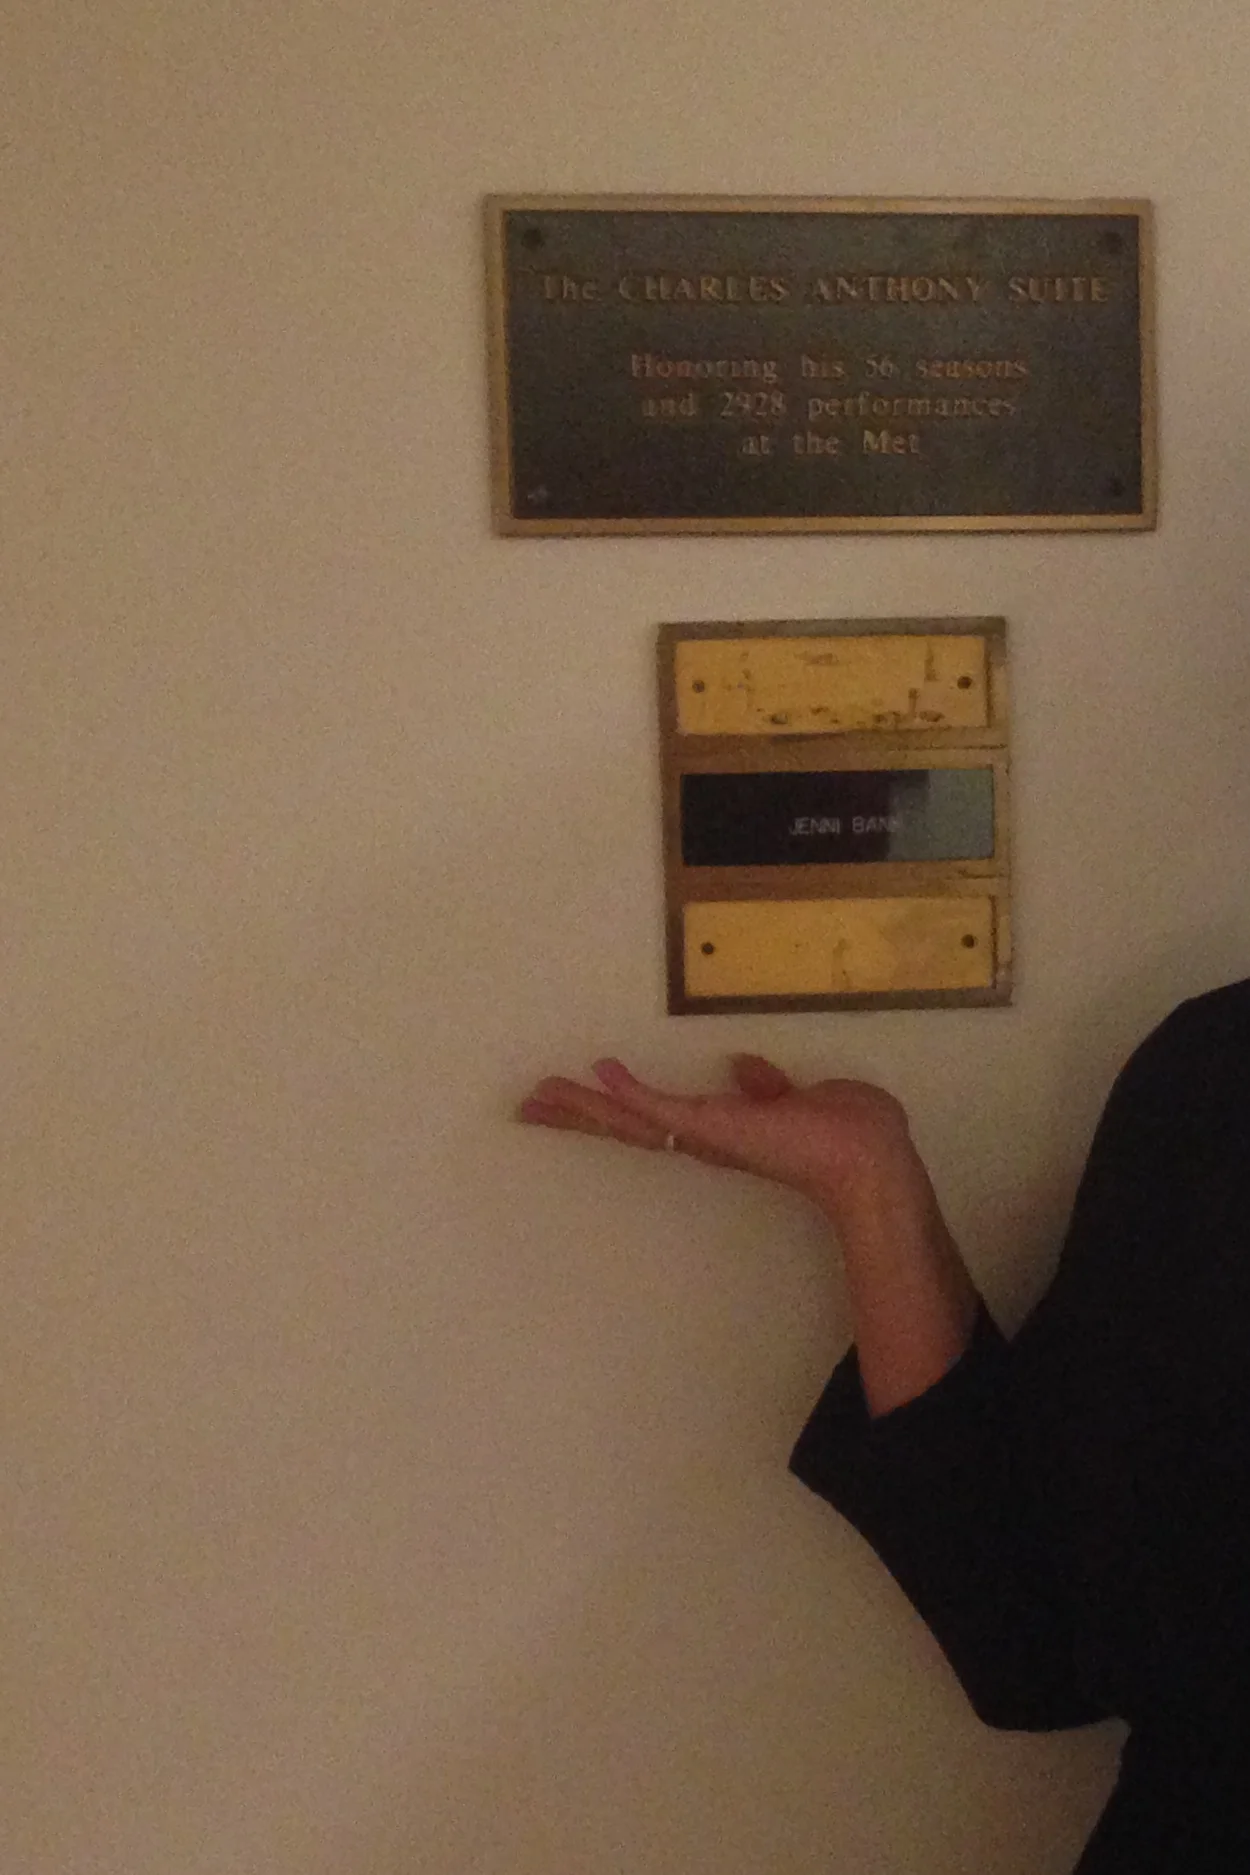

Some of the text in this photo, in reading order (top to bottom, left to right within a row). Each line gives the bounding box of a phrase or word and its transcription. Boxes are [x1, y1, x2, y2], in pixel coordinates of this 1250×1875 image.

[541, 274, 1109, 302] The CHARLES ANTHONY SUITE
[630, 353, 1028, 381] Honoring his 56 seasons
[641, 391, 1017, 421] and 2928 performances
[741, 429, 921, 455] at the Met
[789, 816, 841, 836] JENNI
